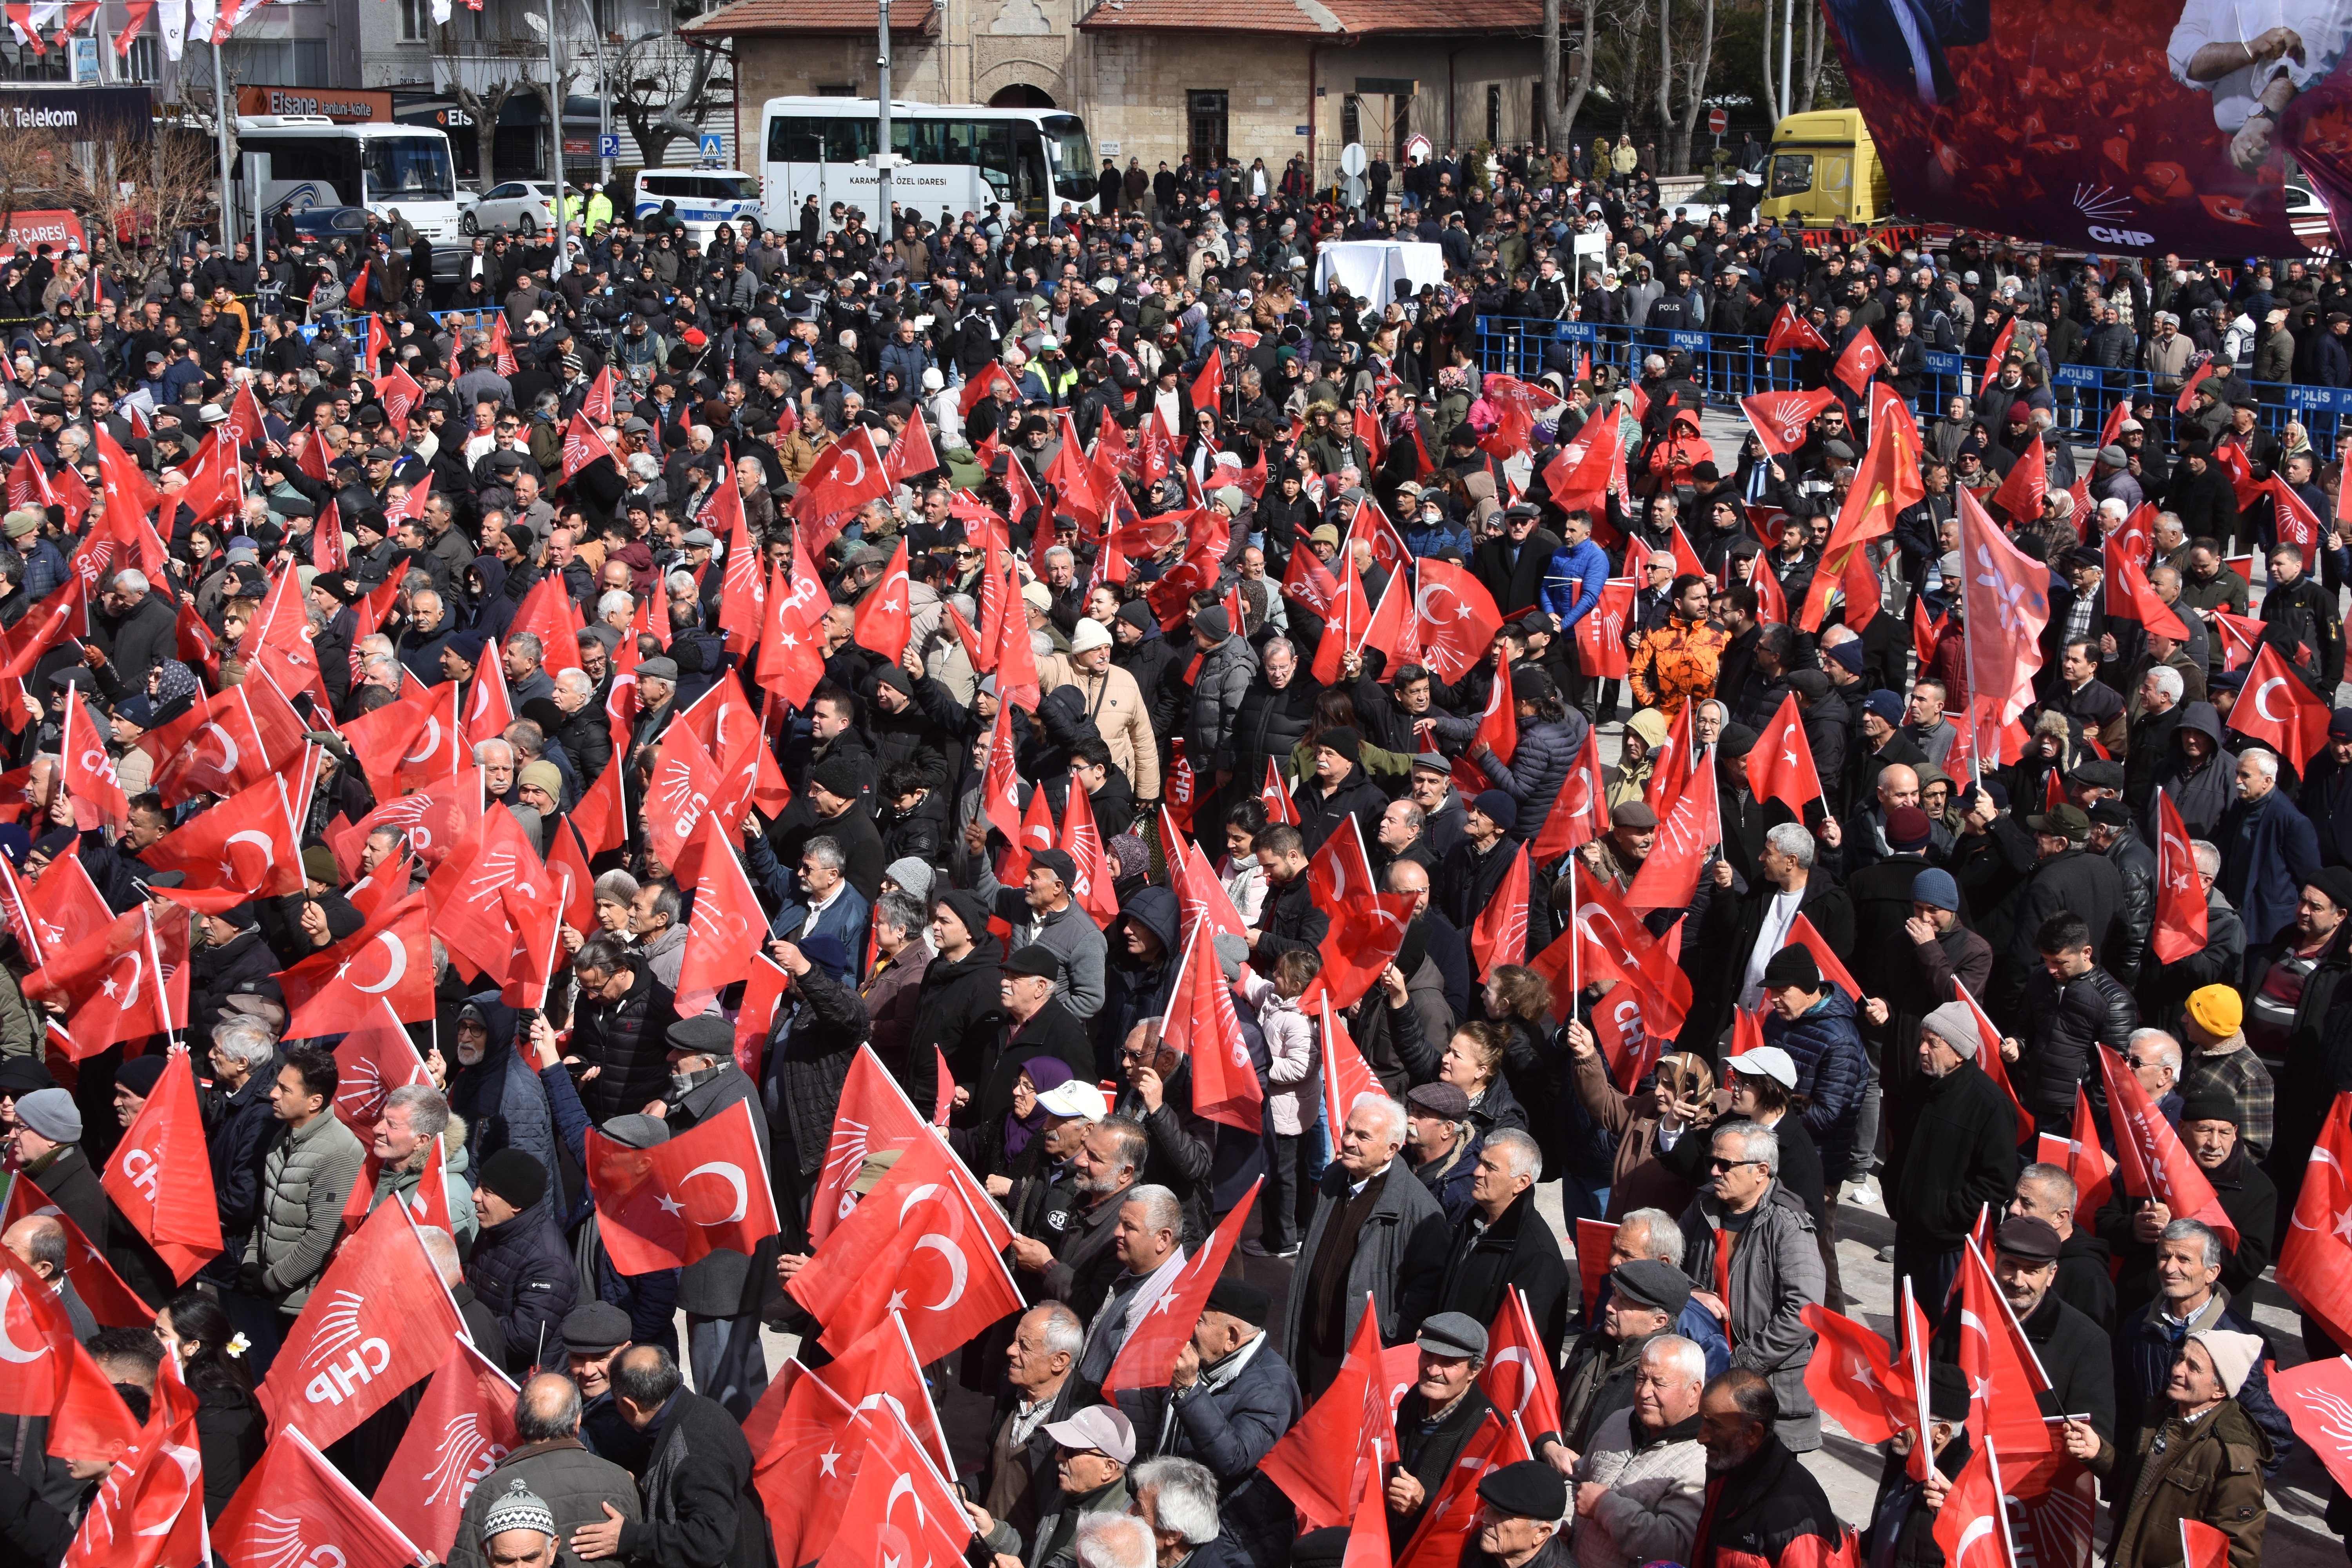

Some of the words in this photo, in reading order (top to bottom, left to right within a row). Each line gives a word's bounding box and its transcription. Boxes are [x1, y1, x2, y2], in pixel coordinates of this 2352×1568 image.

[272, 92, 317, 115] Efsane
[321, 101, 372, 116] tantuni-köfte
[14, 108, 77, 127] Telekom
[448, 111, 499, 126] Efse
[601, 138, 612, 154] P
[896, 176, 915, 185] ÖZEL
[23, 223, 67, 245] ÇARESİ
[2088, 226, 2154, 245] CHP
[1562, 324, 1589, 335] POLİS
[1673, 333, 1702, 345] POLİS
[2059, 367, 2094, 381] POLİS
[76, 554, 99, 583] CHP
[1176, 759, 1191, 802] CHP
[123, 1149, 158, 1201] CH
